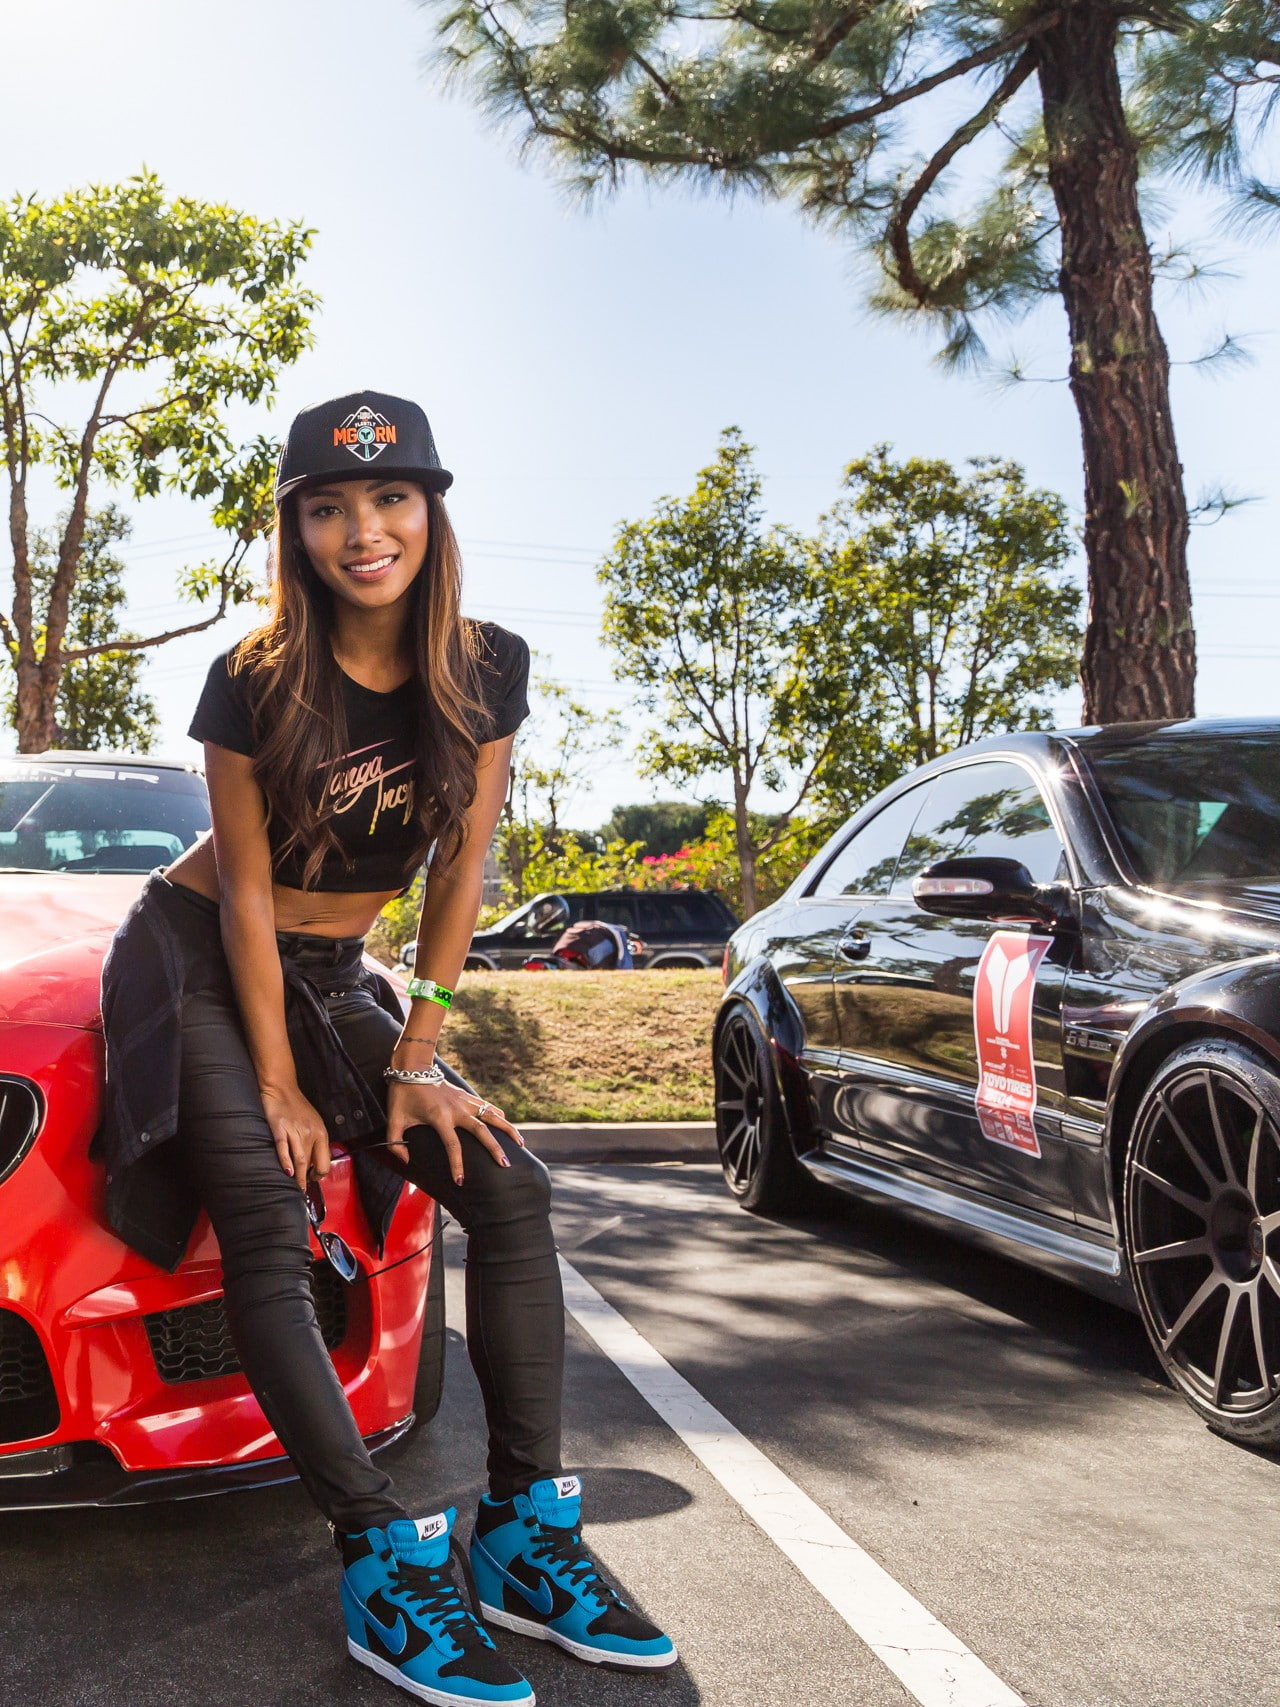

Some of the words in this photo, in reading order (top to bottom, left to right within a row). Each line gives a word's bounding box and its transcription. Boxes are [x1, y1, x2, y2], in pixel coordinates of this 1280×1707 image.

[983, 1071, 1006, 1092] TOYO
[1005, 1079, 1032, 1098] TIRES
[424, 1521, 439, 1533] NIKE
